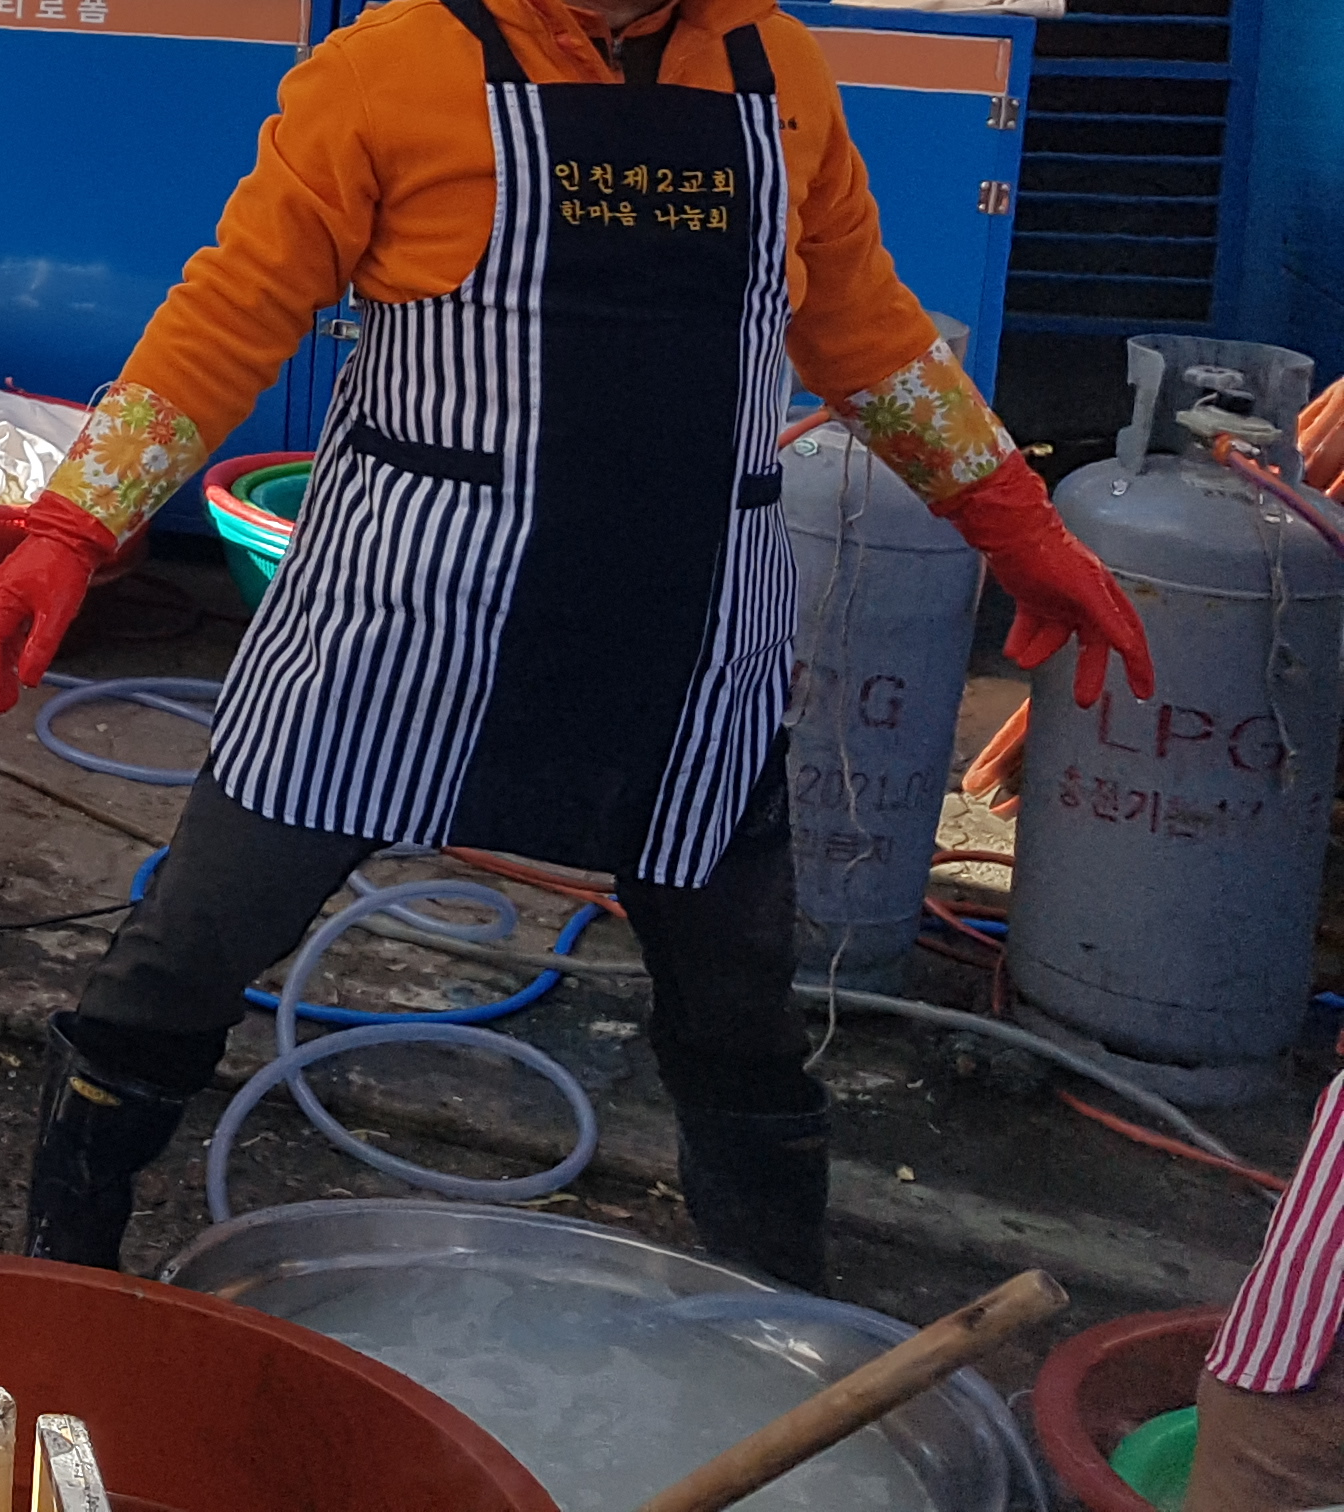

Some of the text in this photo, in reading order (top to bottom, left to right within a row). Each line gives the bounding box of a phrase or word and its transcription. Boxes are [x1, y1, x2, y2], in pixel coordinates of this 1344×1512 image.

[554, 160, 737, 198] 인천제2교회
[559, 199, 728, 232] 한마음 나눔회
[1097, 690, 1288, 772] LPG
